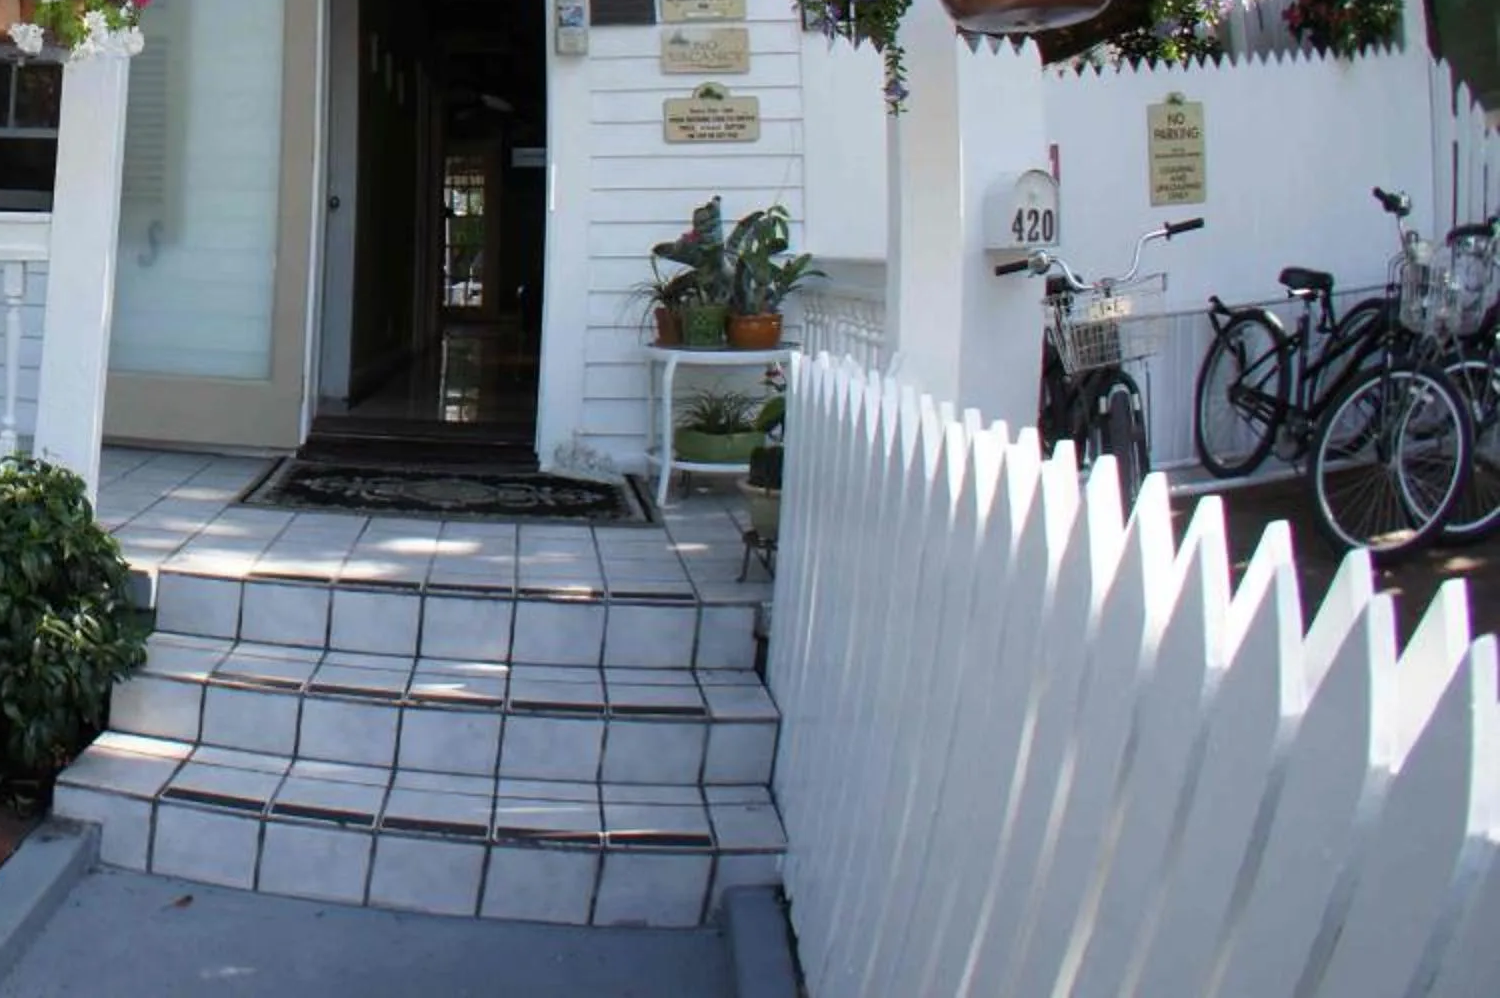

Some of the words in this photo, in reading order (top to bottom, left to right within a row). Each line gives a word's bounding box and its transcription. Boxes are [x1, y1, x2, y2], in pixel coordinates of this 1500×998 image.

[1167, 112, 1186, 125] NO
[1153, 126, 1200, 139] PARKING
[1011, 208, 1055, 243] 420
